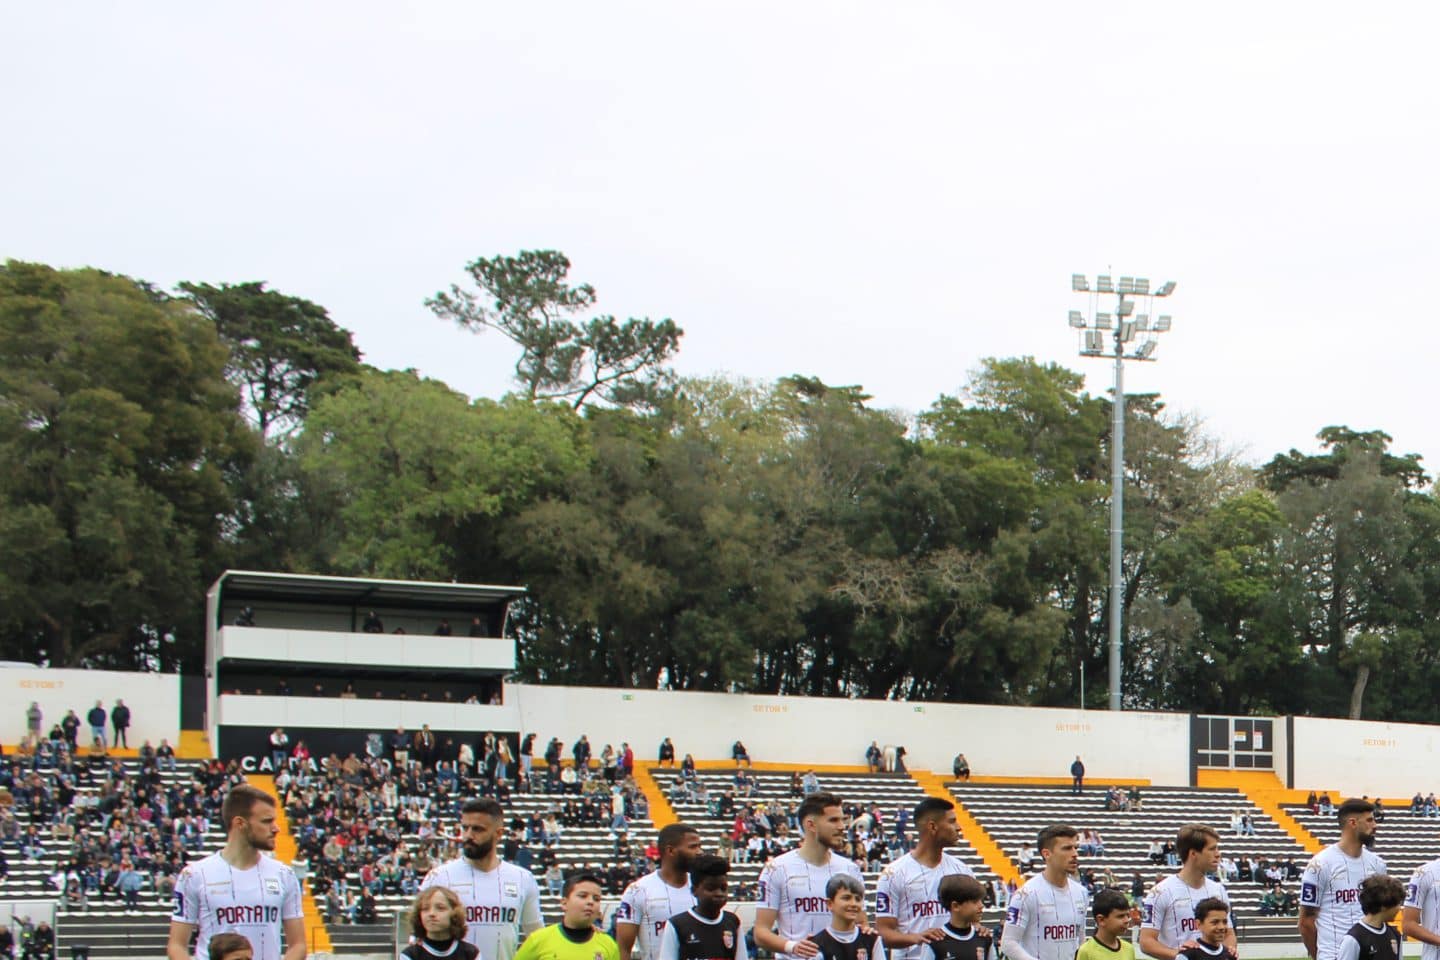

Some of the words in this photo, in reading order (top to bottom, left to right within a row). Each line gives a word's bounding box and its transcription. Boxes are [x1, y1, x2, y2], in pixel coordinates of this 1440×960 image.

[1303, 887, 1314, 902] 3
[877, 898, 888, 912] 3
[216, 904, 279, 925] PORTA10
[465, 905, 516, 923] ORTA10
